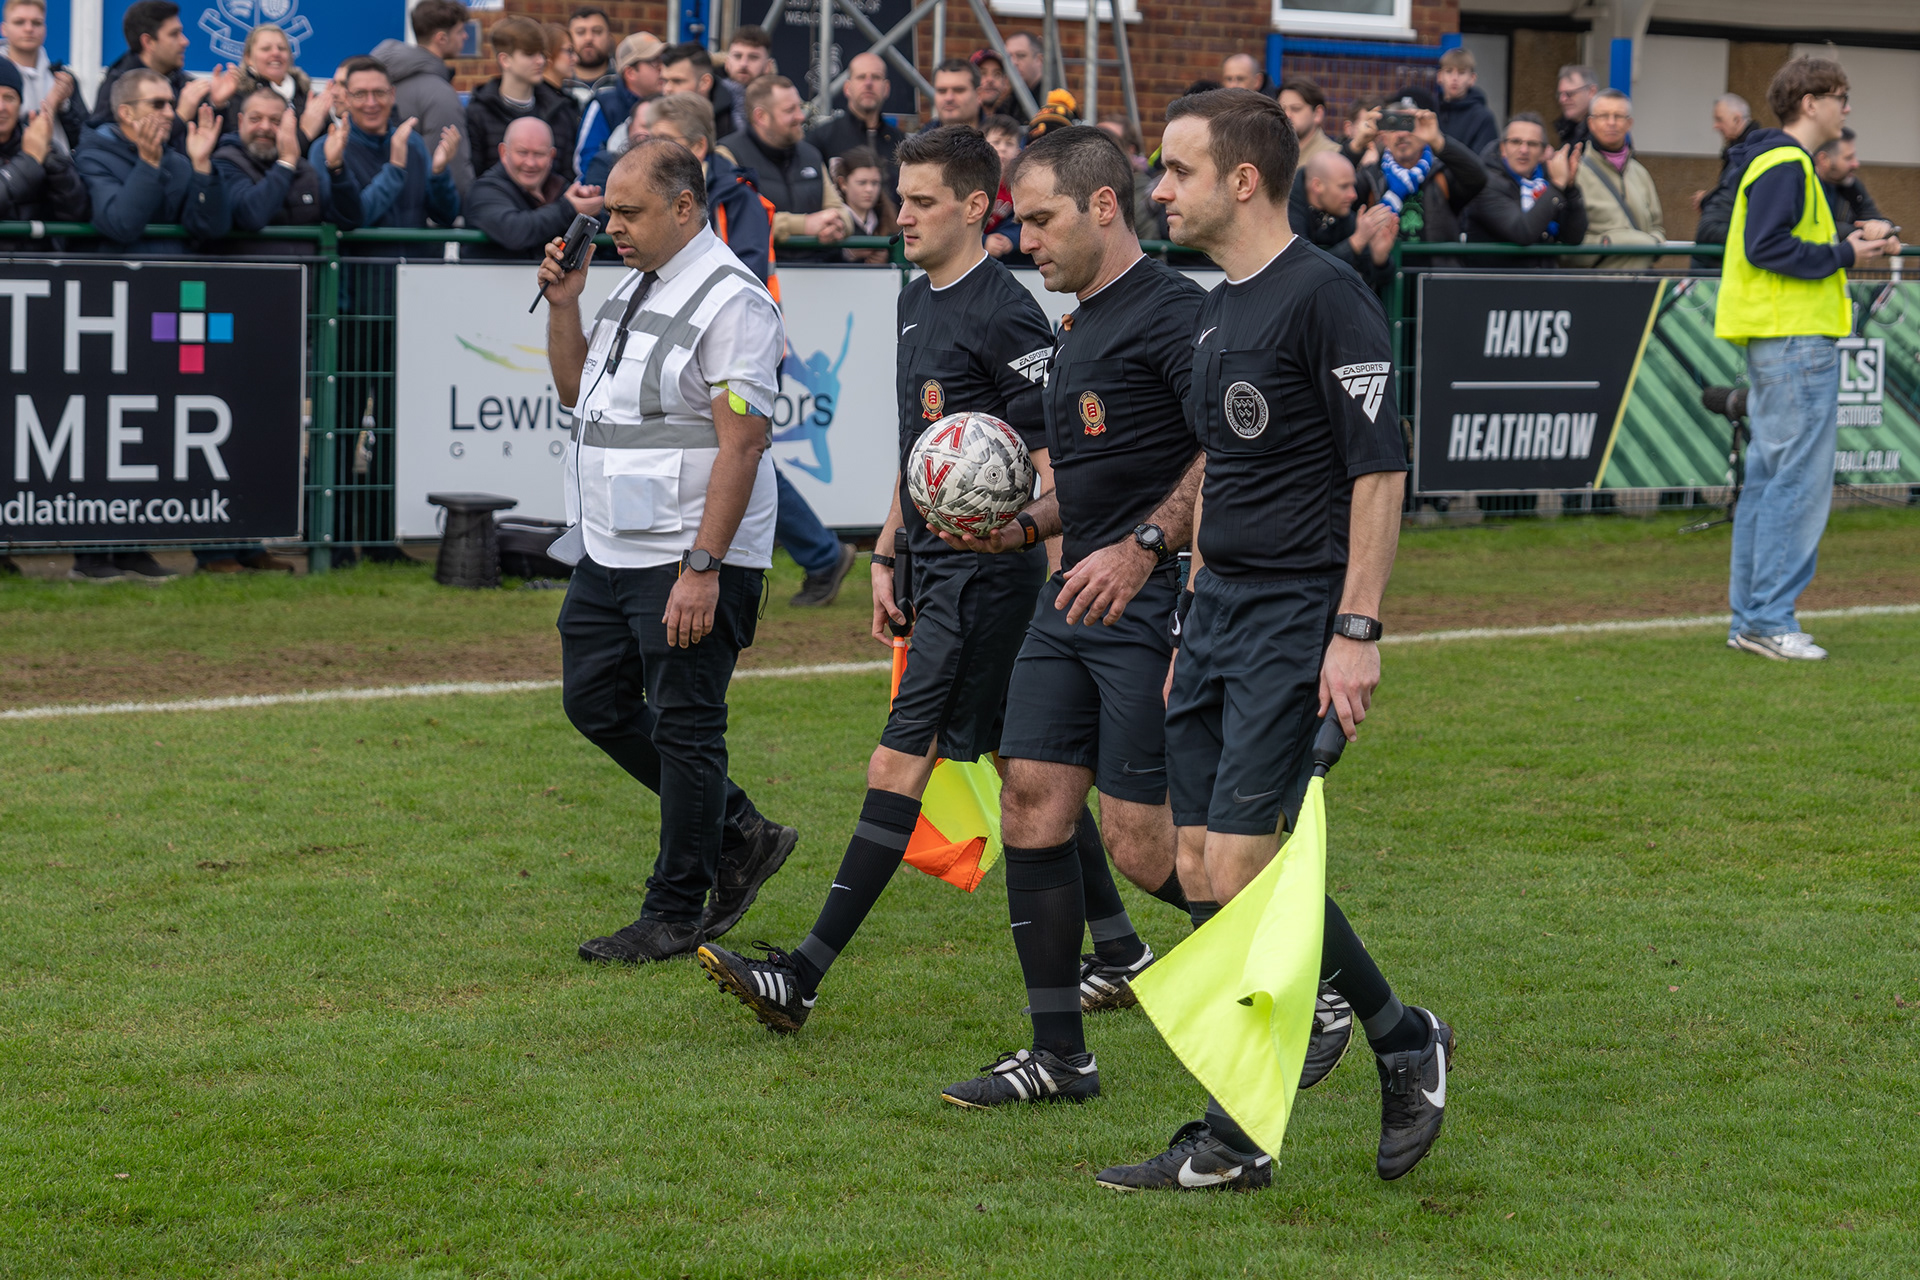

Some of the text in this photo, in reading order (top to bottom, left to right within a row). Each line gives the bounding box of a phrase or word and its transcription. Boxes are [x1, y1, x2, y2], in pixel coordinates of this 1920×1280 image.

[0, 279, 129, 373] TH
[1484, 310, 1571, 357] HAYES
[1356, 364, 1384, 373] SPORTS
[1841, 349, 1876, 391] LS
[450, 384, 573, 431] Lewis
[14, 394, 233, 482] MER
[1447, 413, 1598, 461] HEATHROW
[0, 489, 230, 525] dlatimer.co.uk
